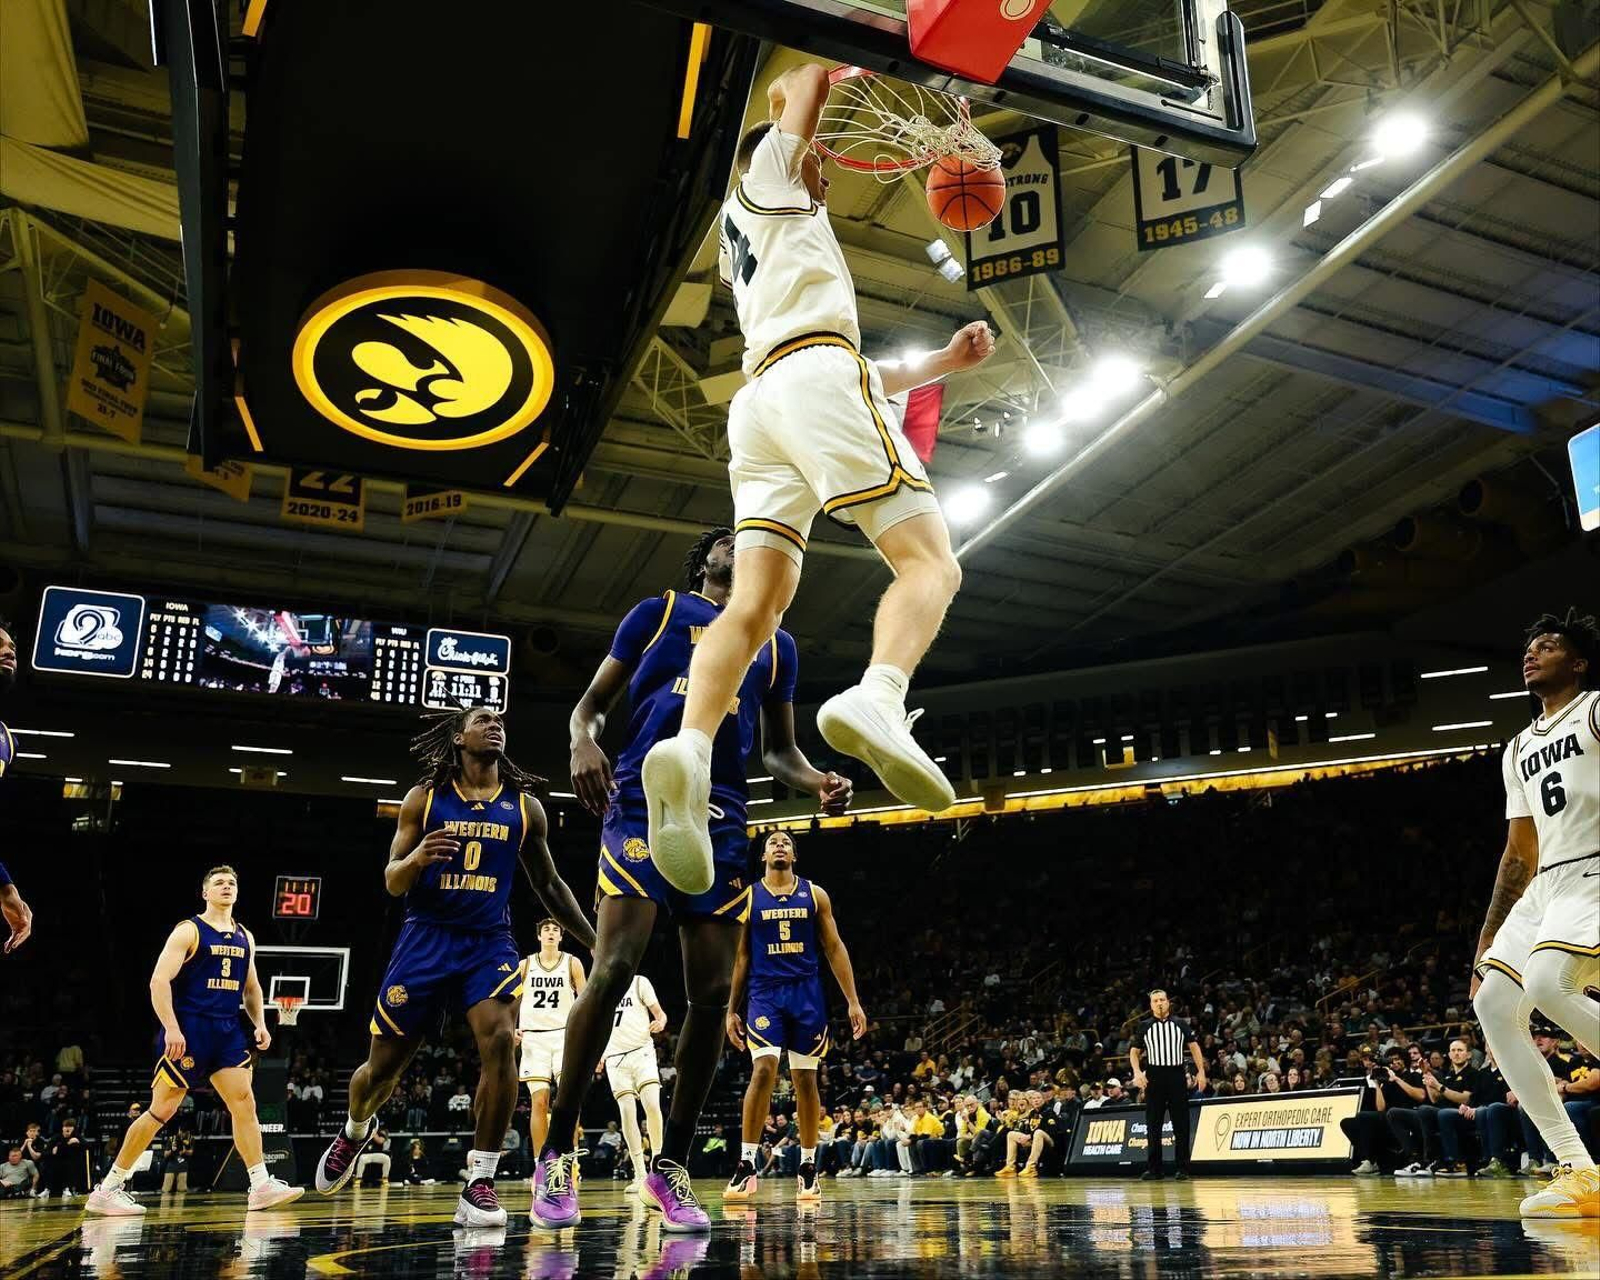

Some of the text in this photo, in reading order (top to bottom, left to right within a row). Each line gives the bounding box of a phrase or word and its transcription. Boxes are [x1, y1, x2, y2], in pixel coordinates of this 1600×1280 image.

[1155, 158, 1213, 202] 17
[1144, 207, 1239, 243] 1945-48
[971, 248, 1060, 282] 1986-89
[92, 302, 145, 350] IOWA
[287, 502, 358, 522] 2020-24
[165, 602, 189, 612] IOWA
[451, 682, 481, 698] 11:11
[1520, 732, 1585, 783] IOWA
[1540, 770, 1567, 818] 6
[443, 820, 510, 842] WESTERN
[464, 841, 482, 871] 0
[440, 873, 498, 893] ILLINOIS
[282, 894, 311, 914] 20
[761, 908, 808, 921] WESTERN
[779, 920, 790, 941] 5
[210, 945, 245, 958] WESTERN
[767, 942, 804, 955] ILLINOIS
[221, 958, 231, 978] 3
[206, 978, 240, 991] ILLINOIS
[530, 976, 564, 988] IOWA
[533, 990, 560, 1009] 24
[1235, 1111, 1262, 1128] EXPERT
[1262, 1108, 1310, 1127] ORTHOPEDIC
[1085, 1120, 1126, 1144] IOWA
[1232, 1128, 1320, 1149] NOW IN NORTH LIBERTY.
[1082, 1144, 1123, 1156] HEALTH CARE
